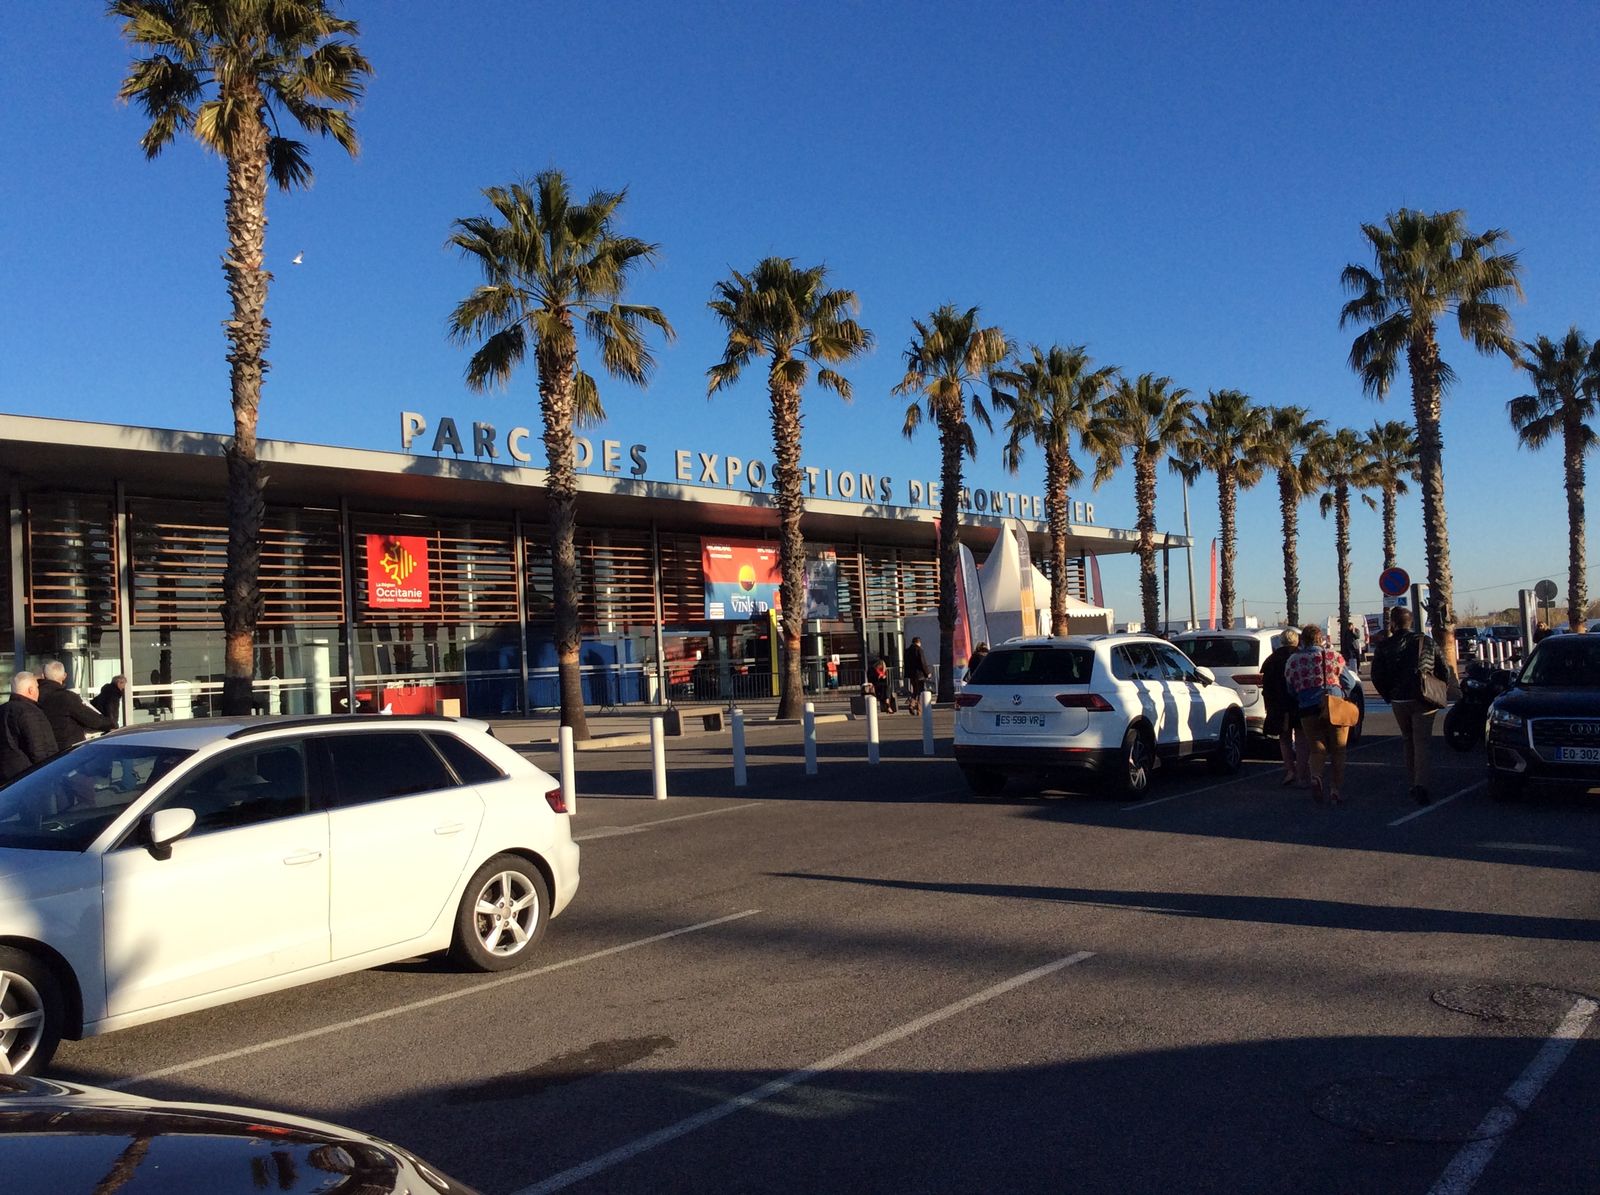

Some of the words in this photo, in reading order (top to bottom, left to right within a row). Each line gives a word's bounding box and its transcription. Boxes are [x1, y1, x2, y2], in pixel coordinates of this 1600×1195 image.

[401, 411, 532, 462] PARC
[572, 437, 647, 475] DES
[909, 479, 939, 505] DE
[376, 587, 422, 598] Occitanie
